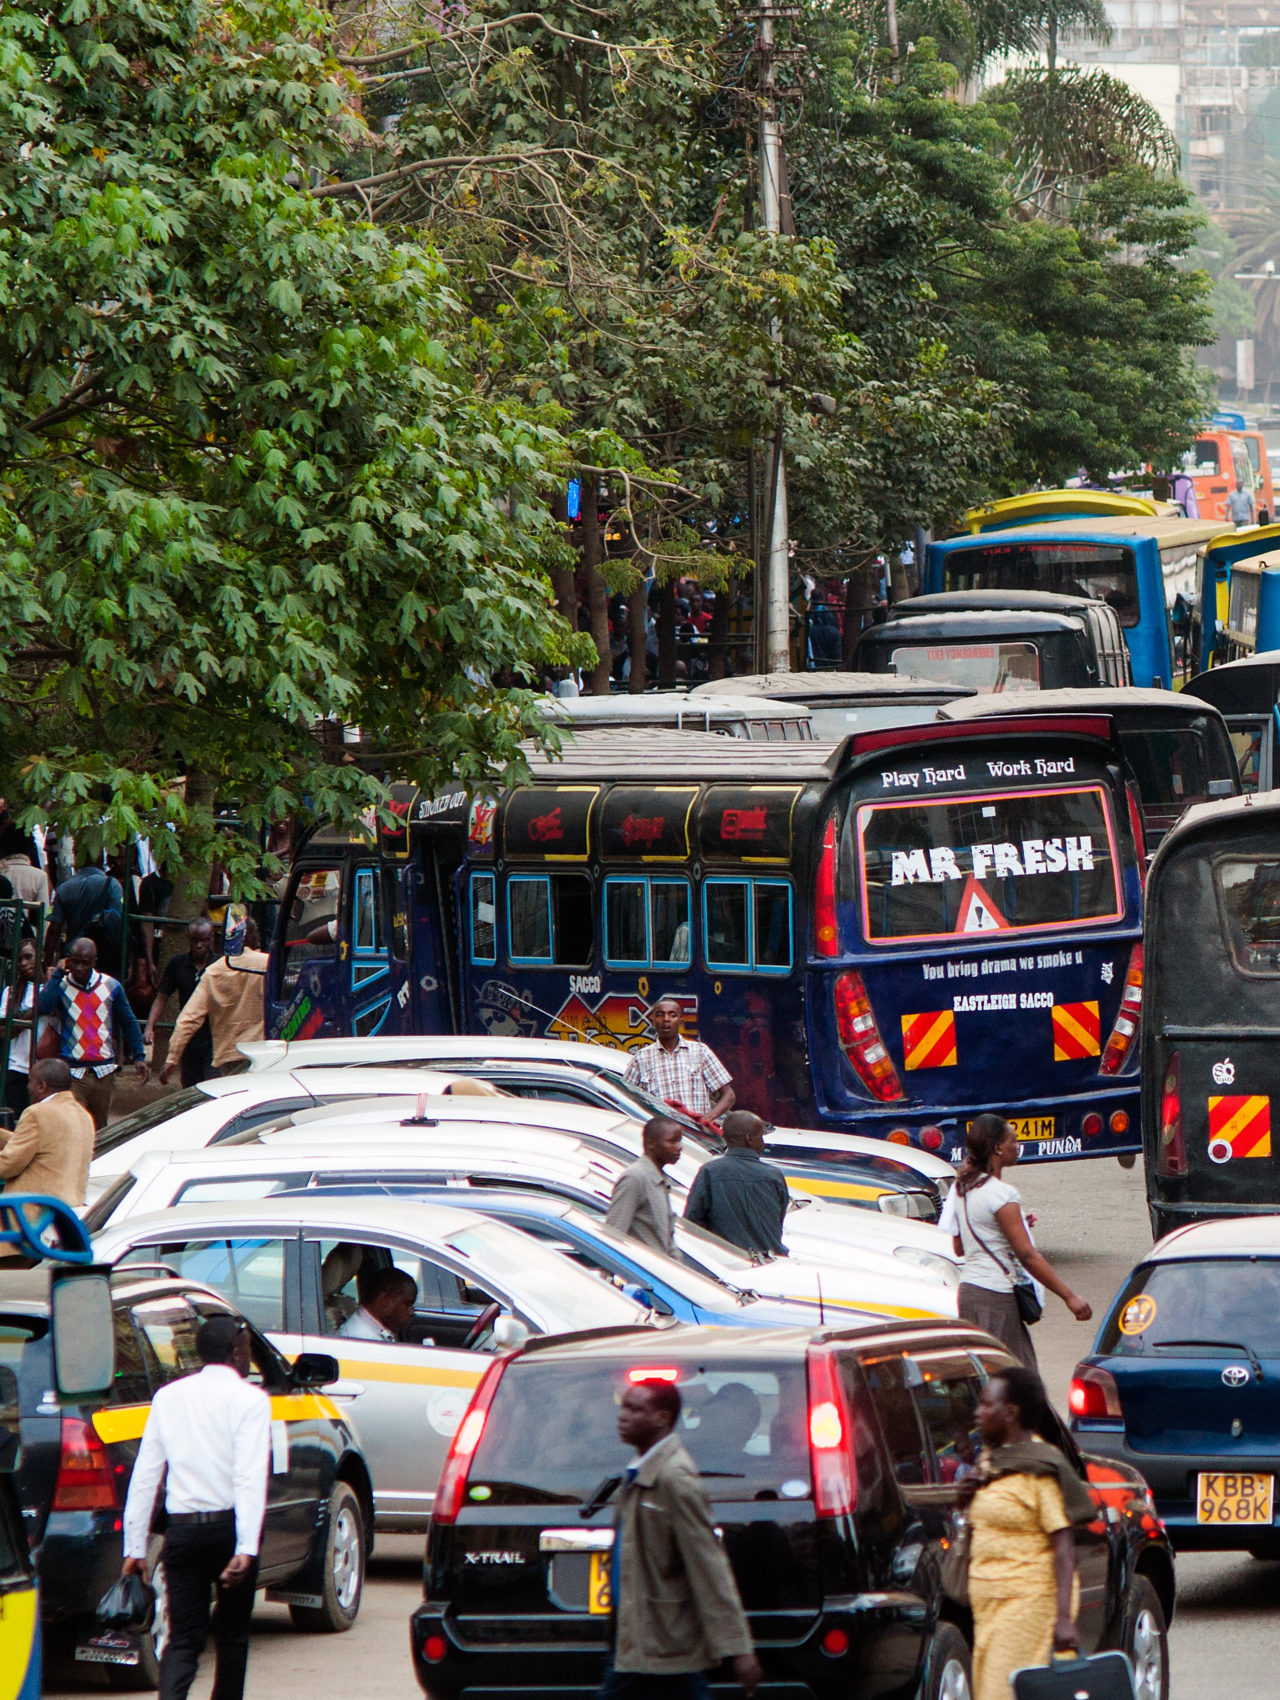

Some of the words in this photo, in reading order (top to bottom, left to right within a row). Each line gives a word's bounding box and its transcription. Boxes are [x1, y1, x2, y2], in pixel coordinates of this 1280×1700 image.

[987, 760, 1032, 777] Work
[881, 772, 920, 788] Play
[891, 846, 963, 886] MR
[971, 835, 1095, 880] FRESH
[922, 963, 945, 980] You
[947, 959, 979, 978] bring
[981, 956, 1017, 974] drama
[1019, 956, 1035, 971] we
[1037, 949, 1073, 969] smoke
[1075, 950, 1083, 965] u
[569, 974, 600, 994] SACCO
[953, 993, 1018, 1012] EASTLEIGH
[1020, 992, 1054, 1009] SACCO
[1205, 1475, 1256, 1498] KBB
[1200, 1497, 1269, 1521] 968K
[464, 1551, 526, 1565] X-TRAIL
